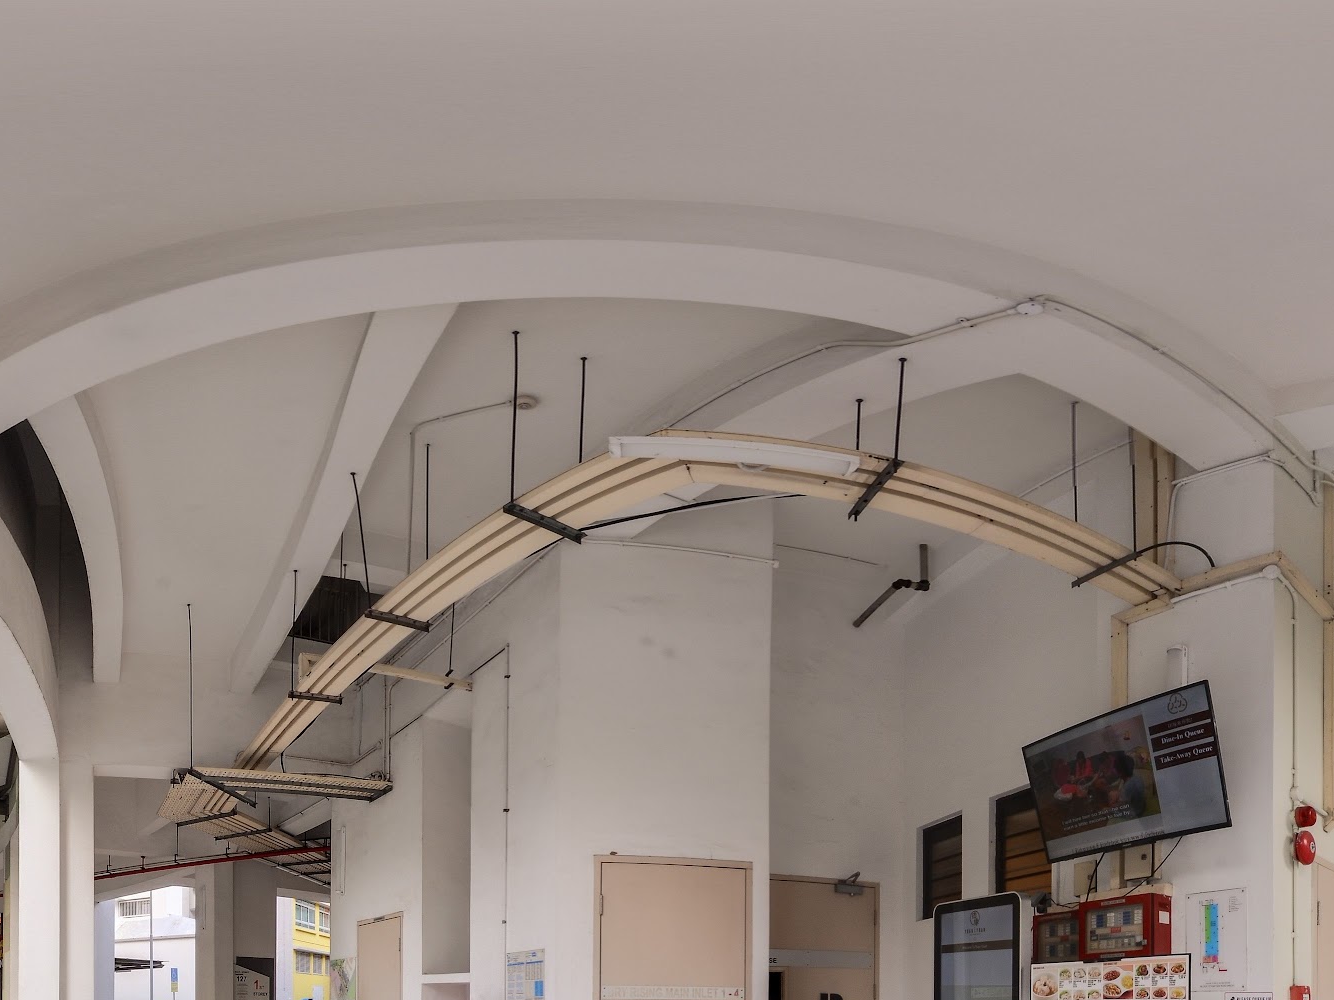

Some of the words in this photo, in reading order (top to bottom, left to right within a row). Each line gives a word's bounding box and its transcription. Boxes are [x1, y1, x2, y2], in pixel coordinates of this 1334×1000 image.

[1161, 732, 1184, 744] Dine-In
[1184, 728, 1204, 739] Queue
[1160, 750, 1192, 764] Take-Away
[1192, 746, 1214, 756] Queue
[630, 988, 663, 997] RISING
[665, 988, 689, 997] MAIN
[692, 988, 718, 998] INLET
